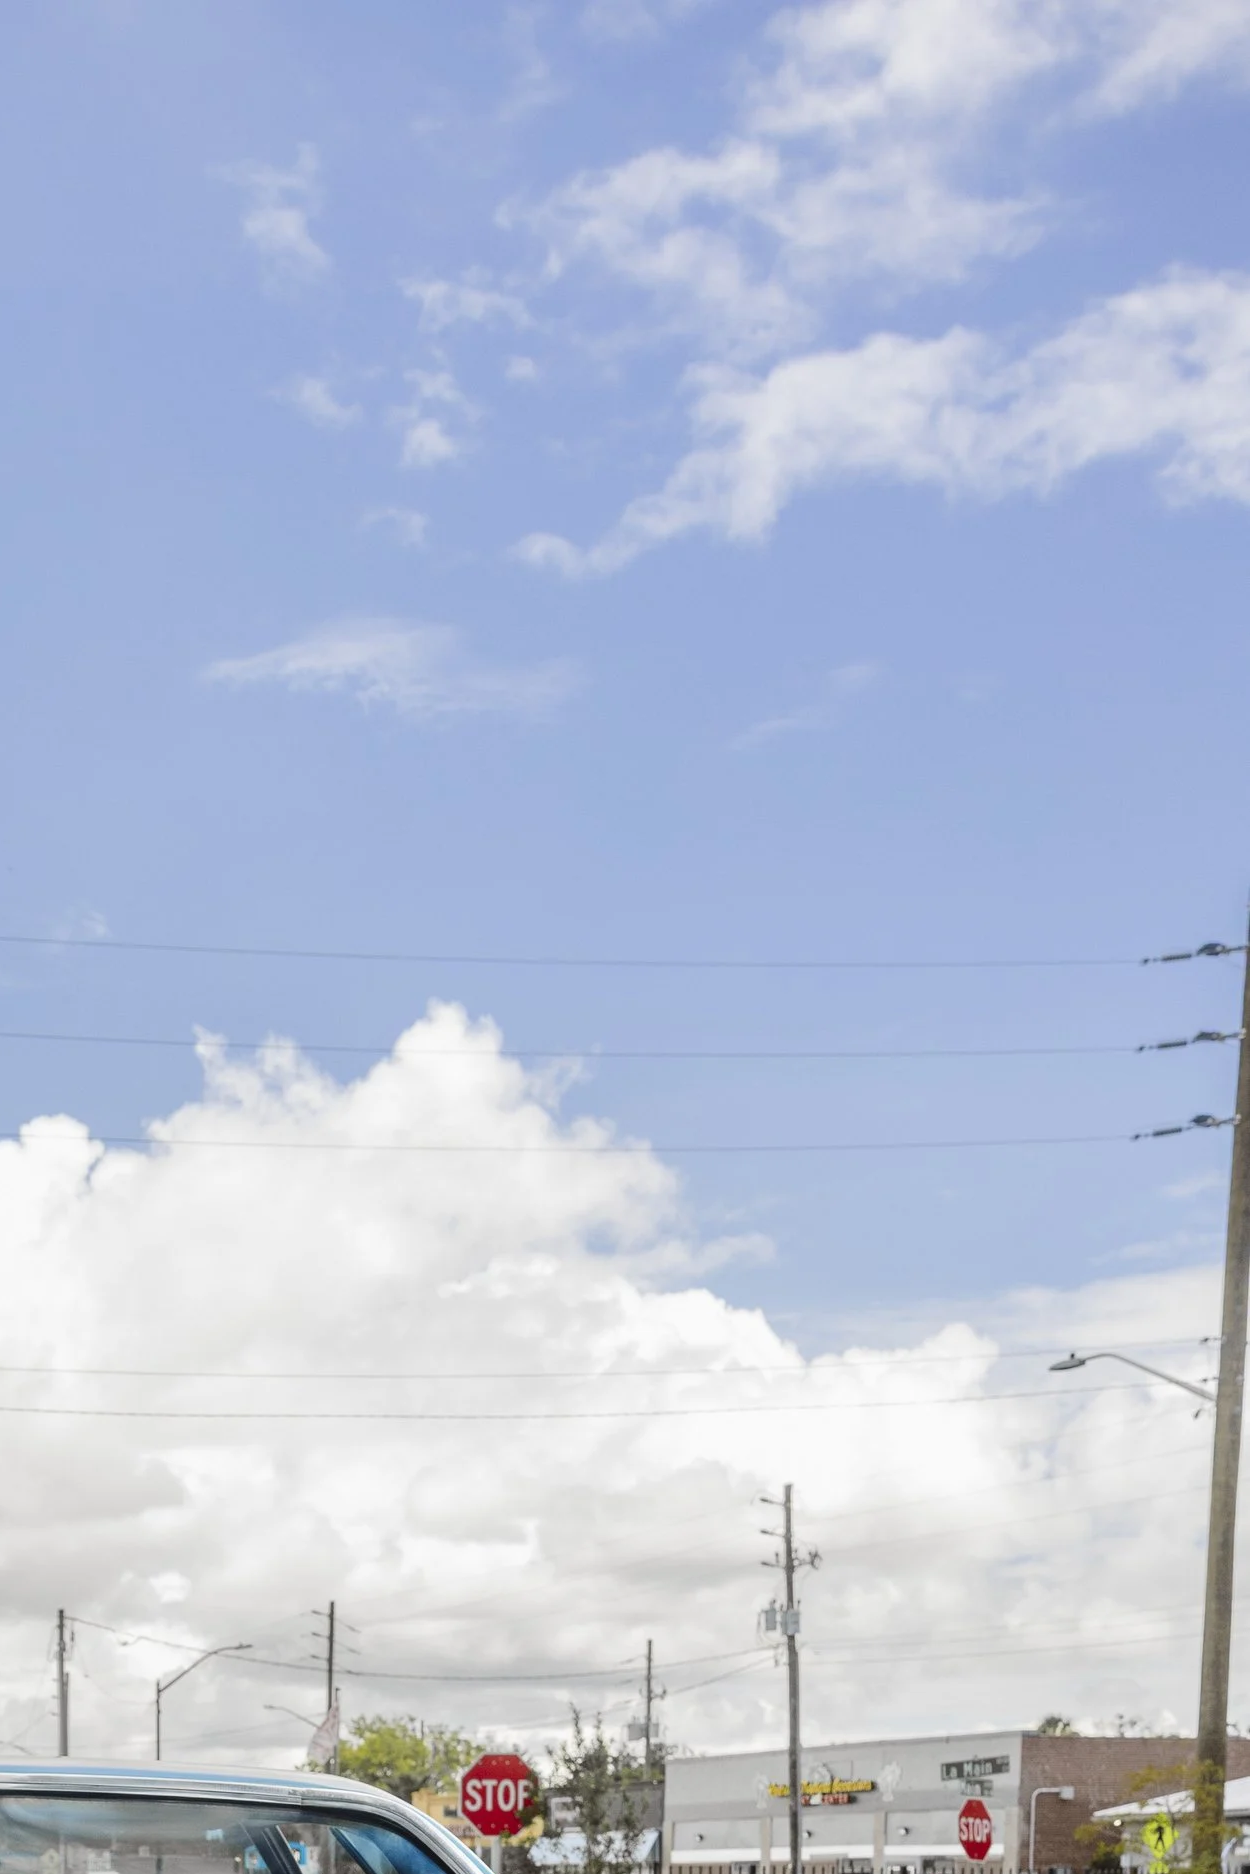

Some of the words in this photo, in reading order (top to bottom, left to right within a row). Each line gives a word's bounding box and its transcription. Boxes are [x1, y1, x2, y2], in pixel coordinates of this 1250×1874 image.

[963, 1760, 993, 1777] Main
[464, 1778, 534, 1812] STOP
[959, 1816, 991, 1842] STOP
